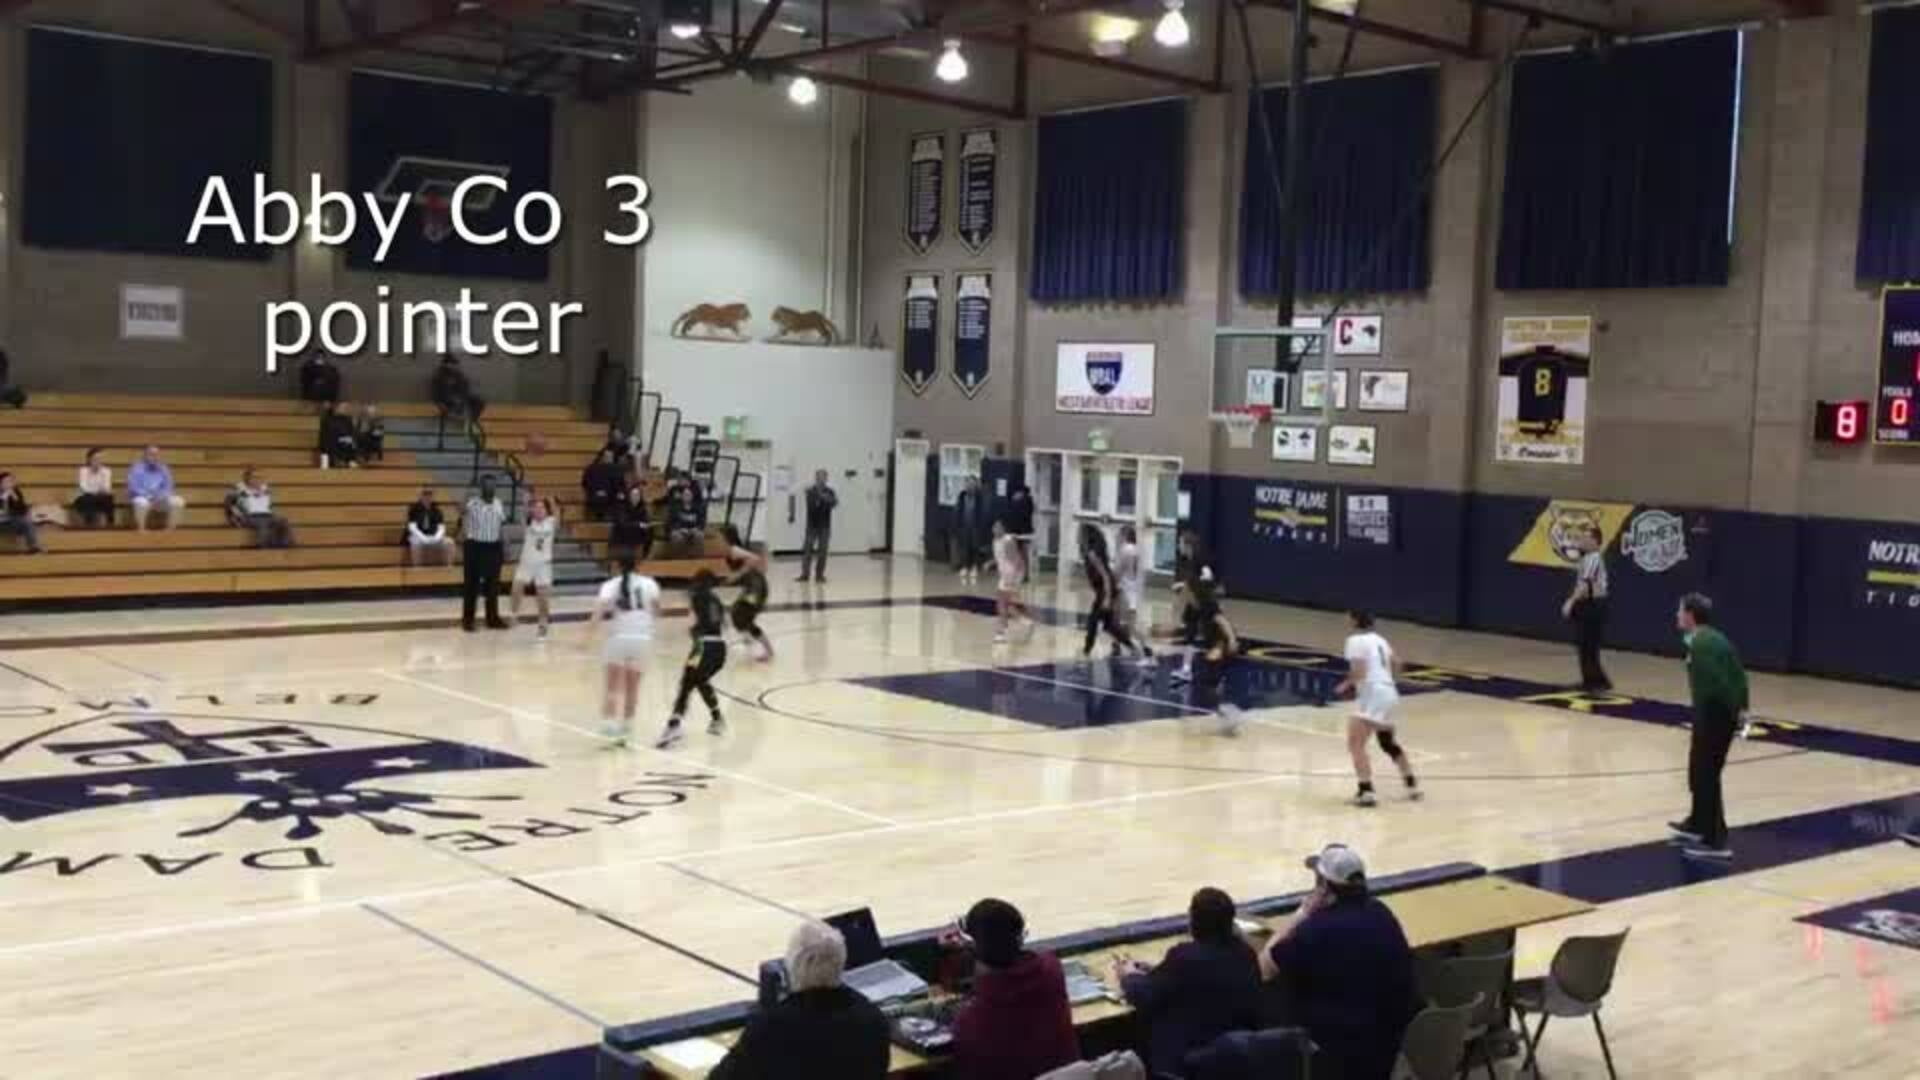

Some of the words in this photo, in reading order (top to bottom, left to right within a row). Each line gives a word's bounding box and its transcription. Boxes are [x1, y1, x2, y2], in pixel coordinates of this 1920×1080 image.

[1534, 367, 1552, 397] 8
[1836, 404, 1858, 440] 8
[1890, 398, 1908, 426] 0
[423, 771, 718, 851] NOTRE
